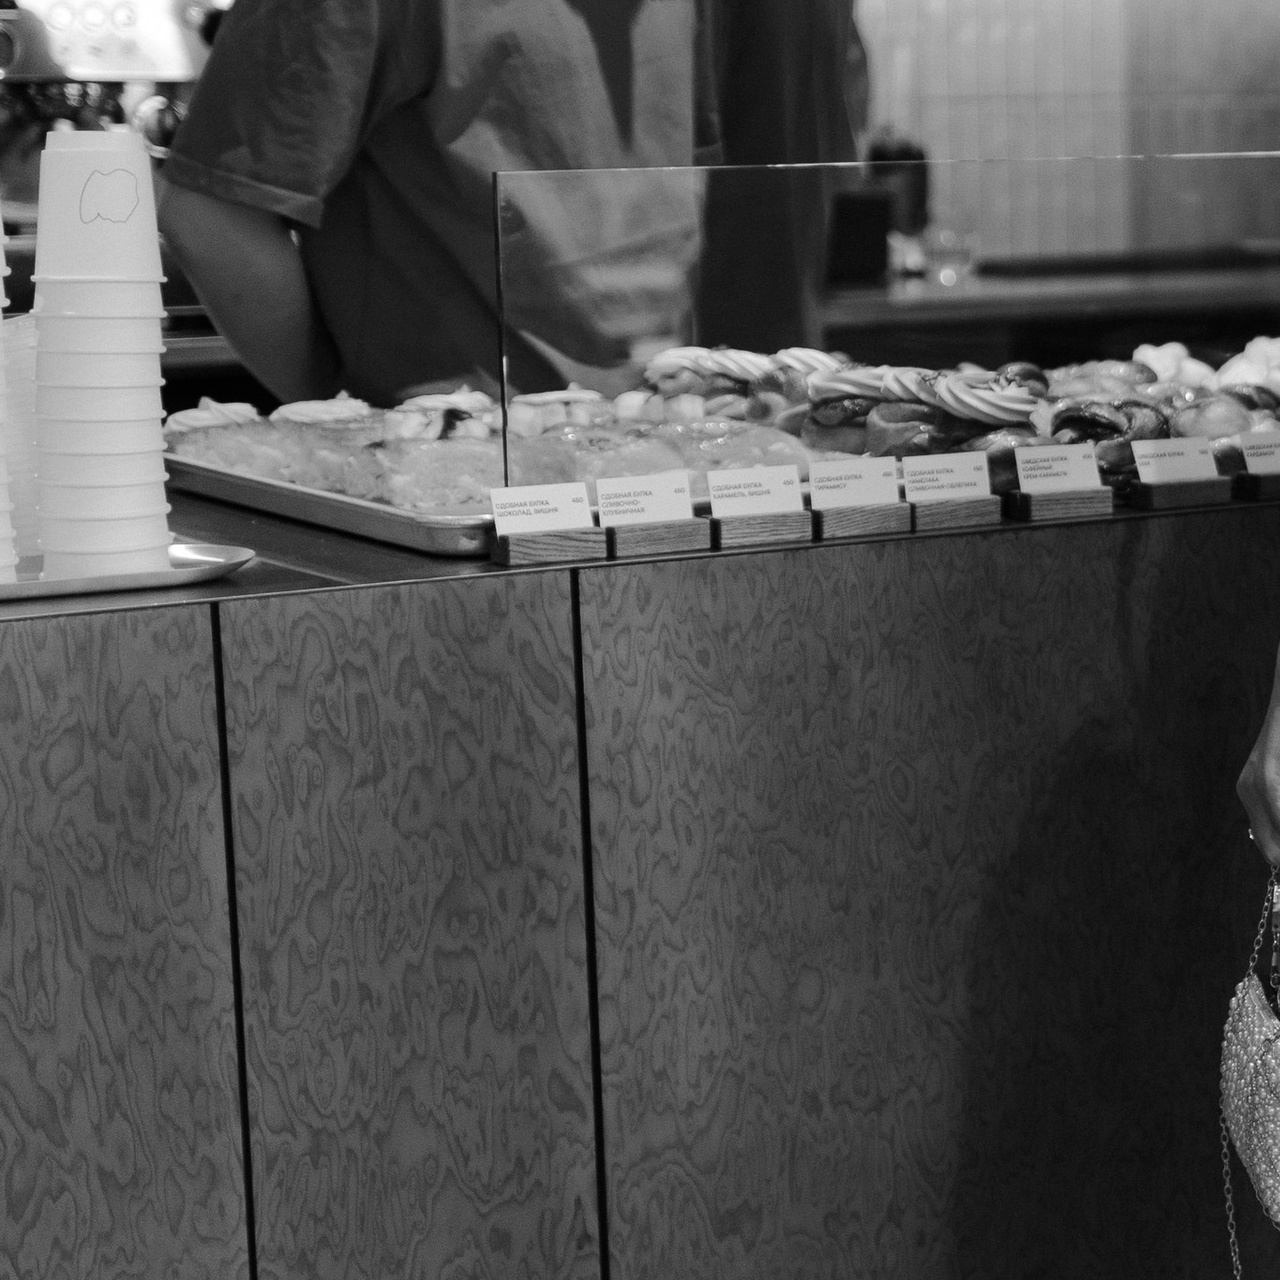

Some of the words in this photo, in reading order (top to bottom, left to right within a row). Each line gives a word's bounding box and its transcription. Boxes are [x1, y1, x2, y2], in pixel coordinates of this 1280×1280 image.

[814, 475, 843, 484] СДОБНАЯ
[712, 483, 742, 492] СДОБНАЯ
[600, 492, 632, 500] СДОБНАЯ
[633, 490, 653, 498] БУЛКА
[748, 489, 771, 497] ВИШНЯ
[495, 501, 528, 510] СДОБНАЯ
[602, 499, 641, 508] СЛИВОЧНО-
[534, 507, 559, 515] ВИШНЯ
[602, 507, 645, 516] КЛУБНИЧНАЯ
